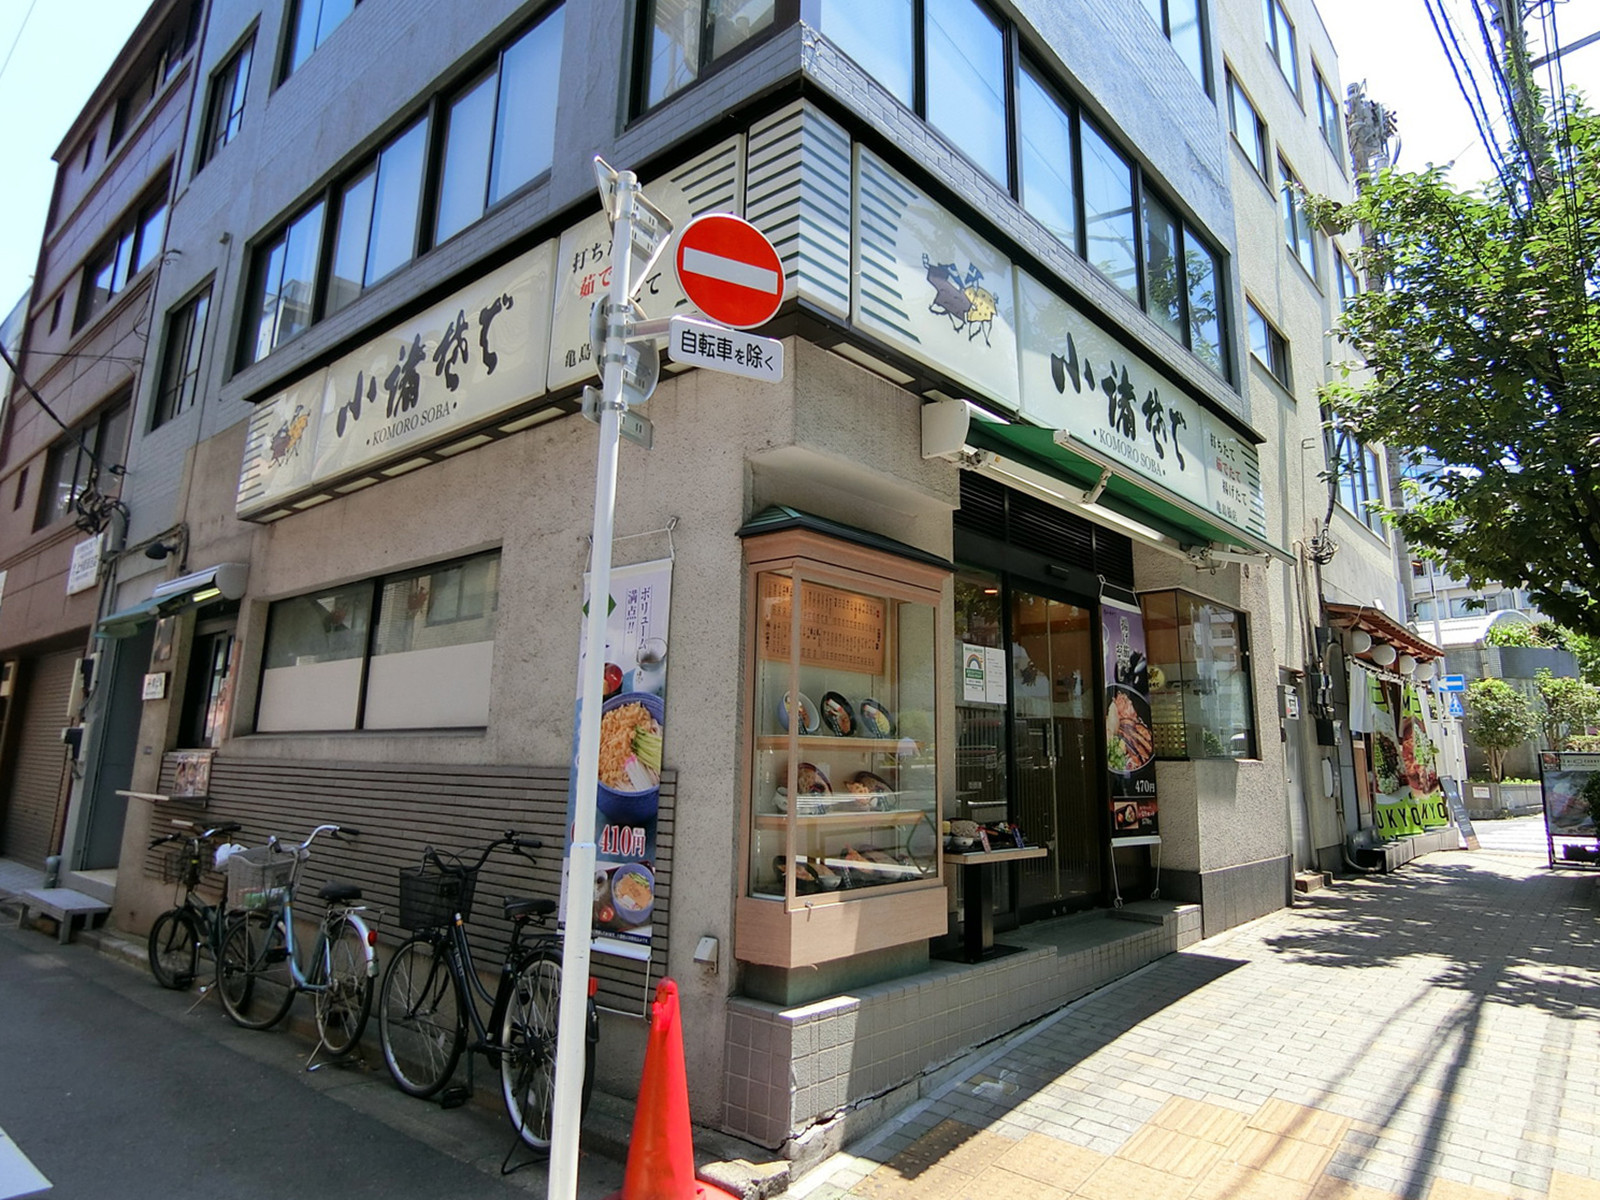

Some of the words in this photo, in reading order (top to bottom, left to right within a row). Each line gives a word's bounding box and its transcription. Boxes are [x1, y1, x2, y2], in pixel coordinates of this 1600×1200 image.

[680, 329, 774, 371] 自転車を除く
[372, 416, 419, 446] KOMORO
[420, 402, 450, 427] SOBA
[1098, 427, 1140, 465] KOMORO
[1140, 455, 1162, 476] SOBA
[638, 586, 651, 650] ボリューム
[1135, 779, 1156, 793] 470円
[599, 825, 646, 857] 410円
